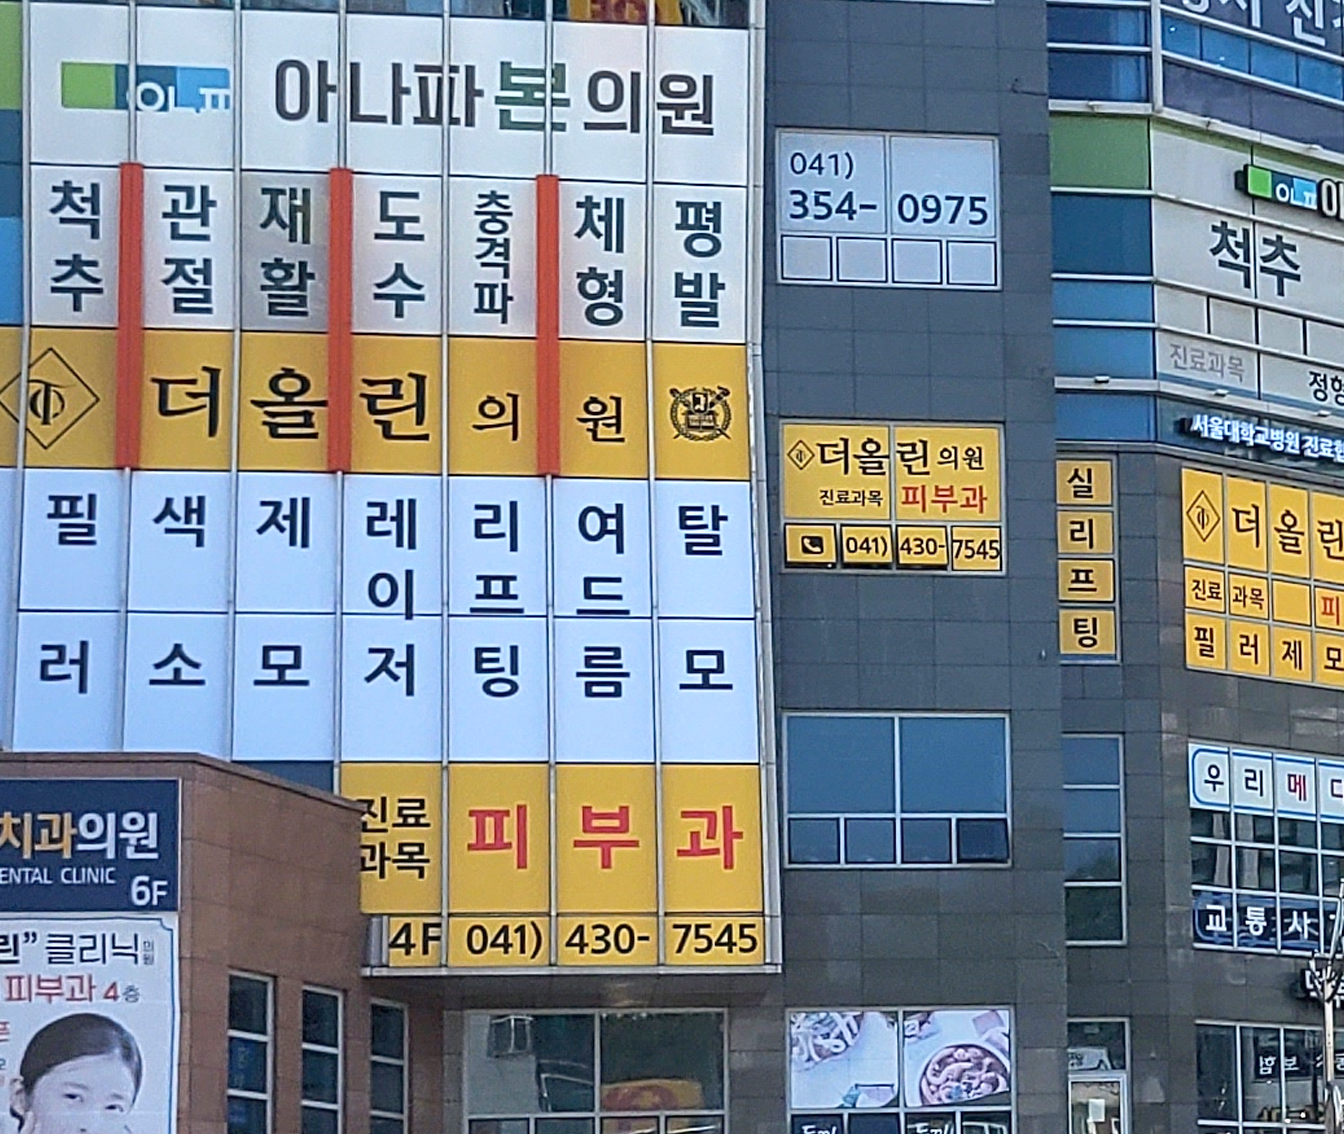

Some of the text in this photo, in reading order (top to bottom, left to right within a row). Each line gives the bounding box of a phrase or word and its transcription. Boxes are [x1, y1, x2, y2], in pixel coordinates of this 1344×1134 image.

[274, 59, 717, 137] 아나파본의원
[789, 190, 989, 226] 354- 0975
[790, 152, 854, 180] 041)
[48, 180, 106, 313] 척추
[162, 185, 219, 316] 관절
[259, 185, 316, 319] 재활
[373, 189, 427, 321] 도수
[474, 190, 515, 326] 충격파
[574, 194, 628, 329] 체형
[672, 198, 727, 330] 평발
[1209, 220, 1302, 296] 척추
[1170, 343, 1245, 382] 진료과목
[819, 485, 988, 514] 진료과목 피부과
[1190, 415, 1300, 456] 서울대학교병원
[39, 495, 100, 695] 필러
[149, 495, 207, 689] 색소
[253, 496, 312, 689] 제모
[363, 498, 419, 697] 레이저
[469, 500, 526, 697] 리프팅
[575, 502, 632, 698] 여드름
[677, 502, 735, 693] 탈모
[846, 536, 1001, 561] 041) 430- 7545
[1067, 468, 1097, 648] 실리프팅
[60, 866, 116, 886] CLINIC
[129, 876, 167, 907] 6F
[466, 804, 746, 873] 피부과
[4, 974, 96, 1005] 피부과
[45, 932, 142, 967] 클리닉
[389, 921, 759, 962] 4F 041) 430- 7545
